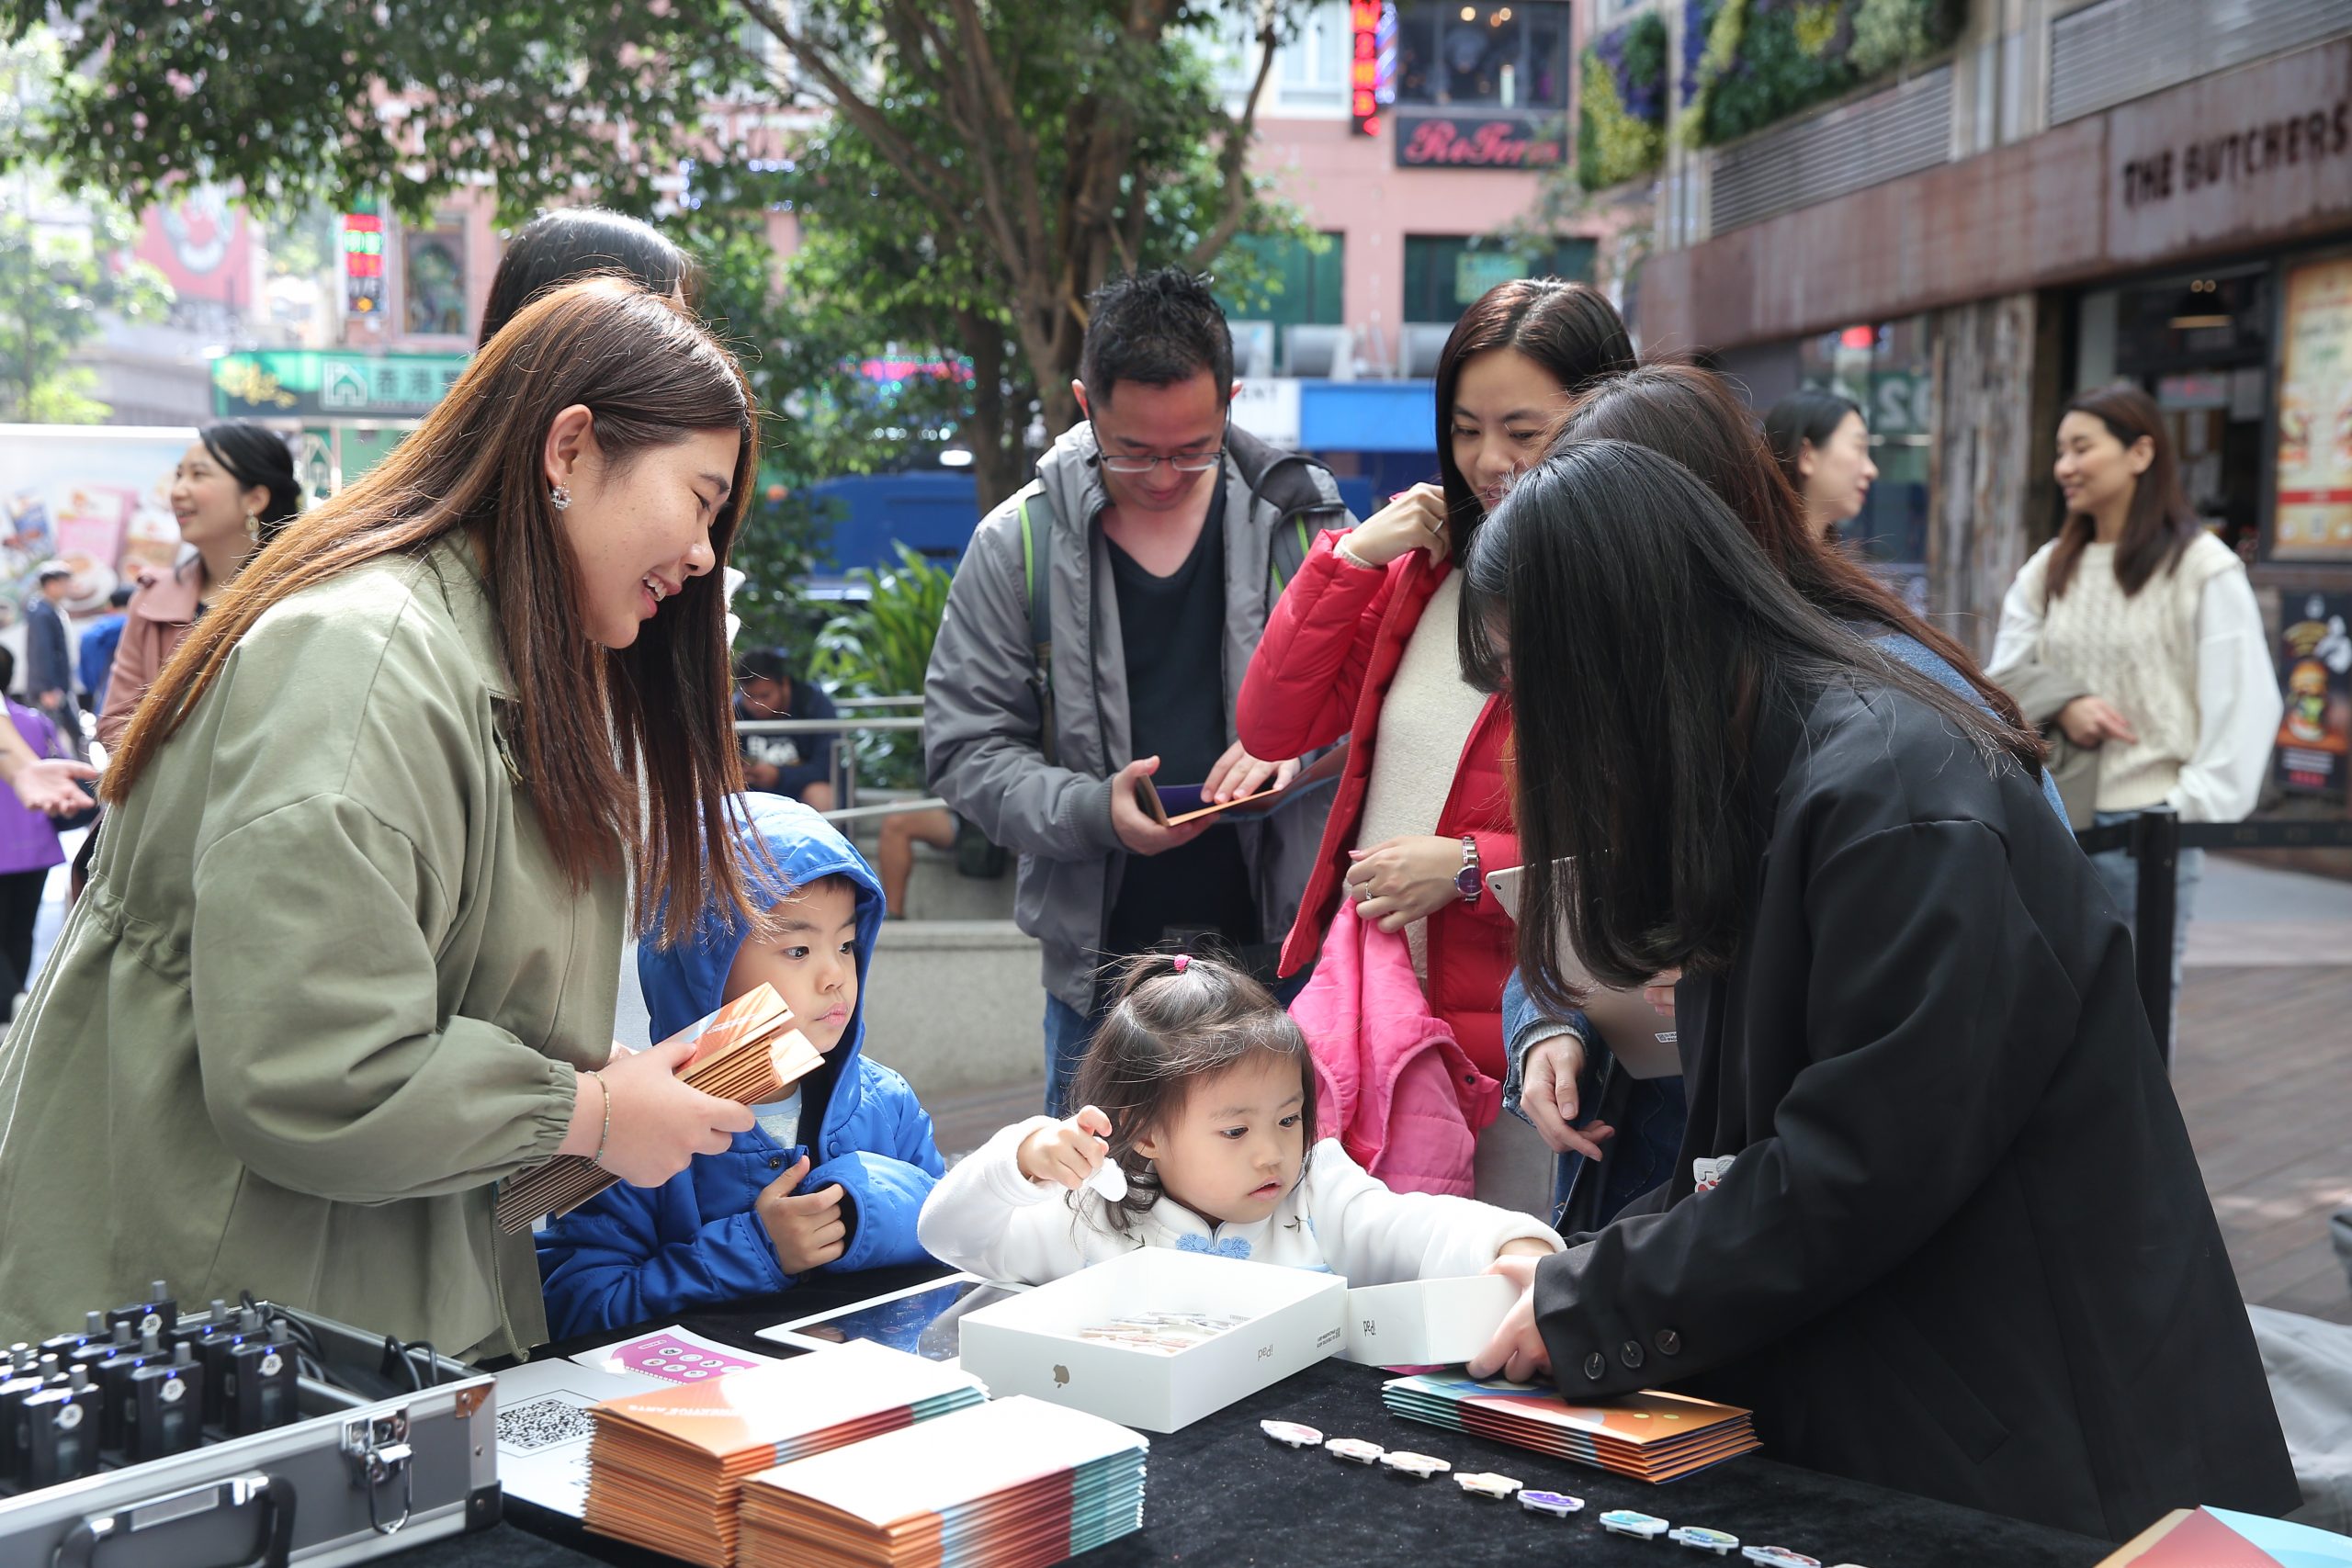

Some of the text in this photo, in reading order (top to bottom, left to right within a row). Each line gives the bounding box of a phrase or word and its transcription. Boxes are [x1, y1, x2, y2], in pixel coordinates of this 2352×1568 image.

[2123, 101, 2349, 209] THE BUTCHERS
[1363, 1320, 1377, 1337] iPad
[1258, 1344, 1273, 1361] iPad
